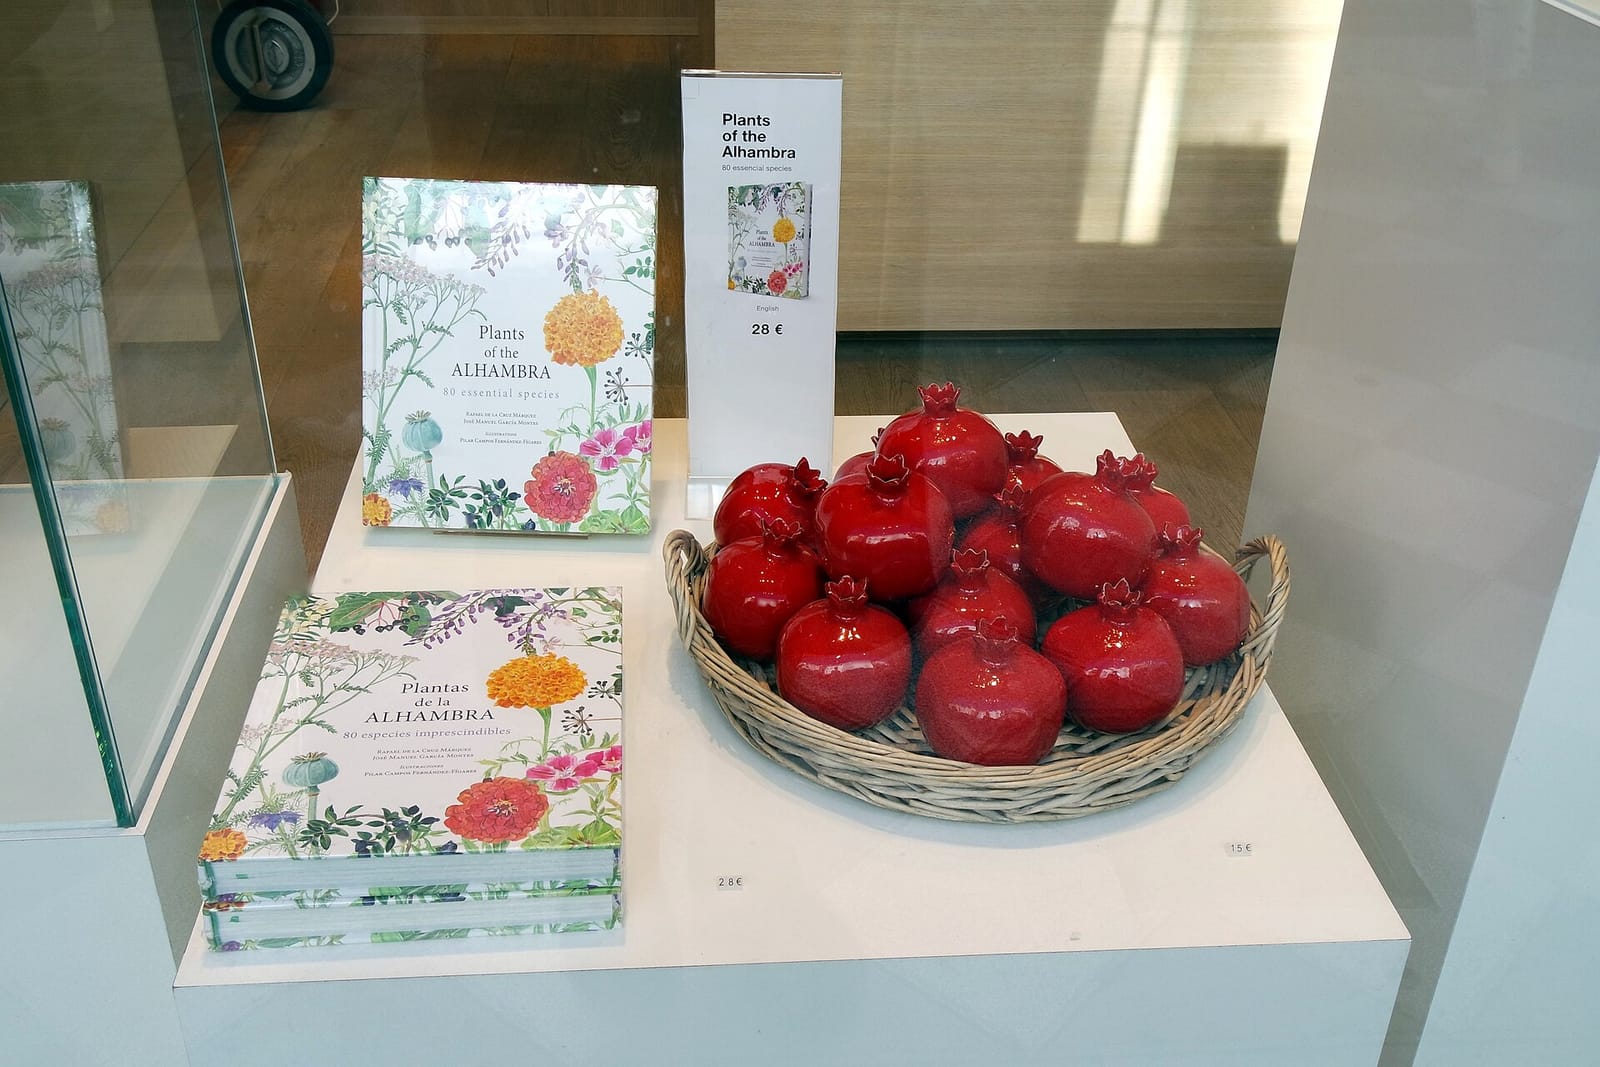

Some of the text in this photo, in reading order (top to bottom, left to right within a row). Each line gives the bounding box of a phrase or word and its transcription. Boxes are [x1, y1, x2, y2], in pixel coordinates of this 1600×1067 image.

[722, 113, 771, 126] Plants
[722, 129, 767, 142] of the
[722, 145, 796, 159] Alhambra
[766, 165, 792, 173] species
[479, 325, 525, 340] Plants
[751, 323, 784, 335] 28 €
[484, 346, 519, 359] of the
[451, 363, 551, 379] ALHAMBRA
[443, 387, 560, 401] 80 essential species
[401, 682, 470, 694] Plantas
[414, 697, 451, 707] de la
[364, 709, 496, 723] ALHAMBRA
[343, 727, 512, 741] 80 especies imprescindibles
